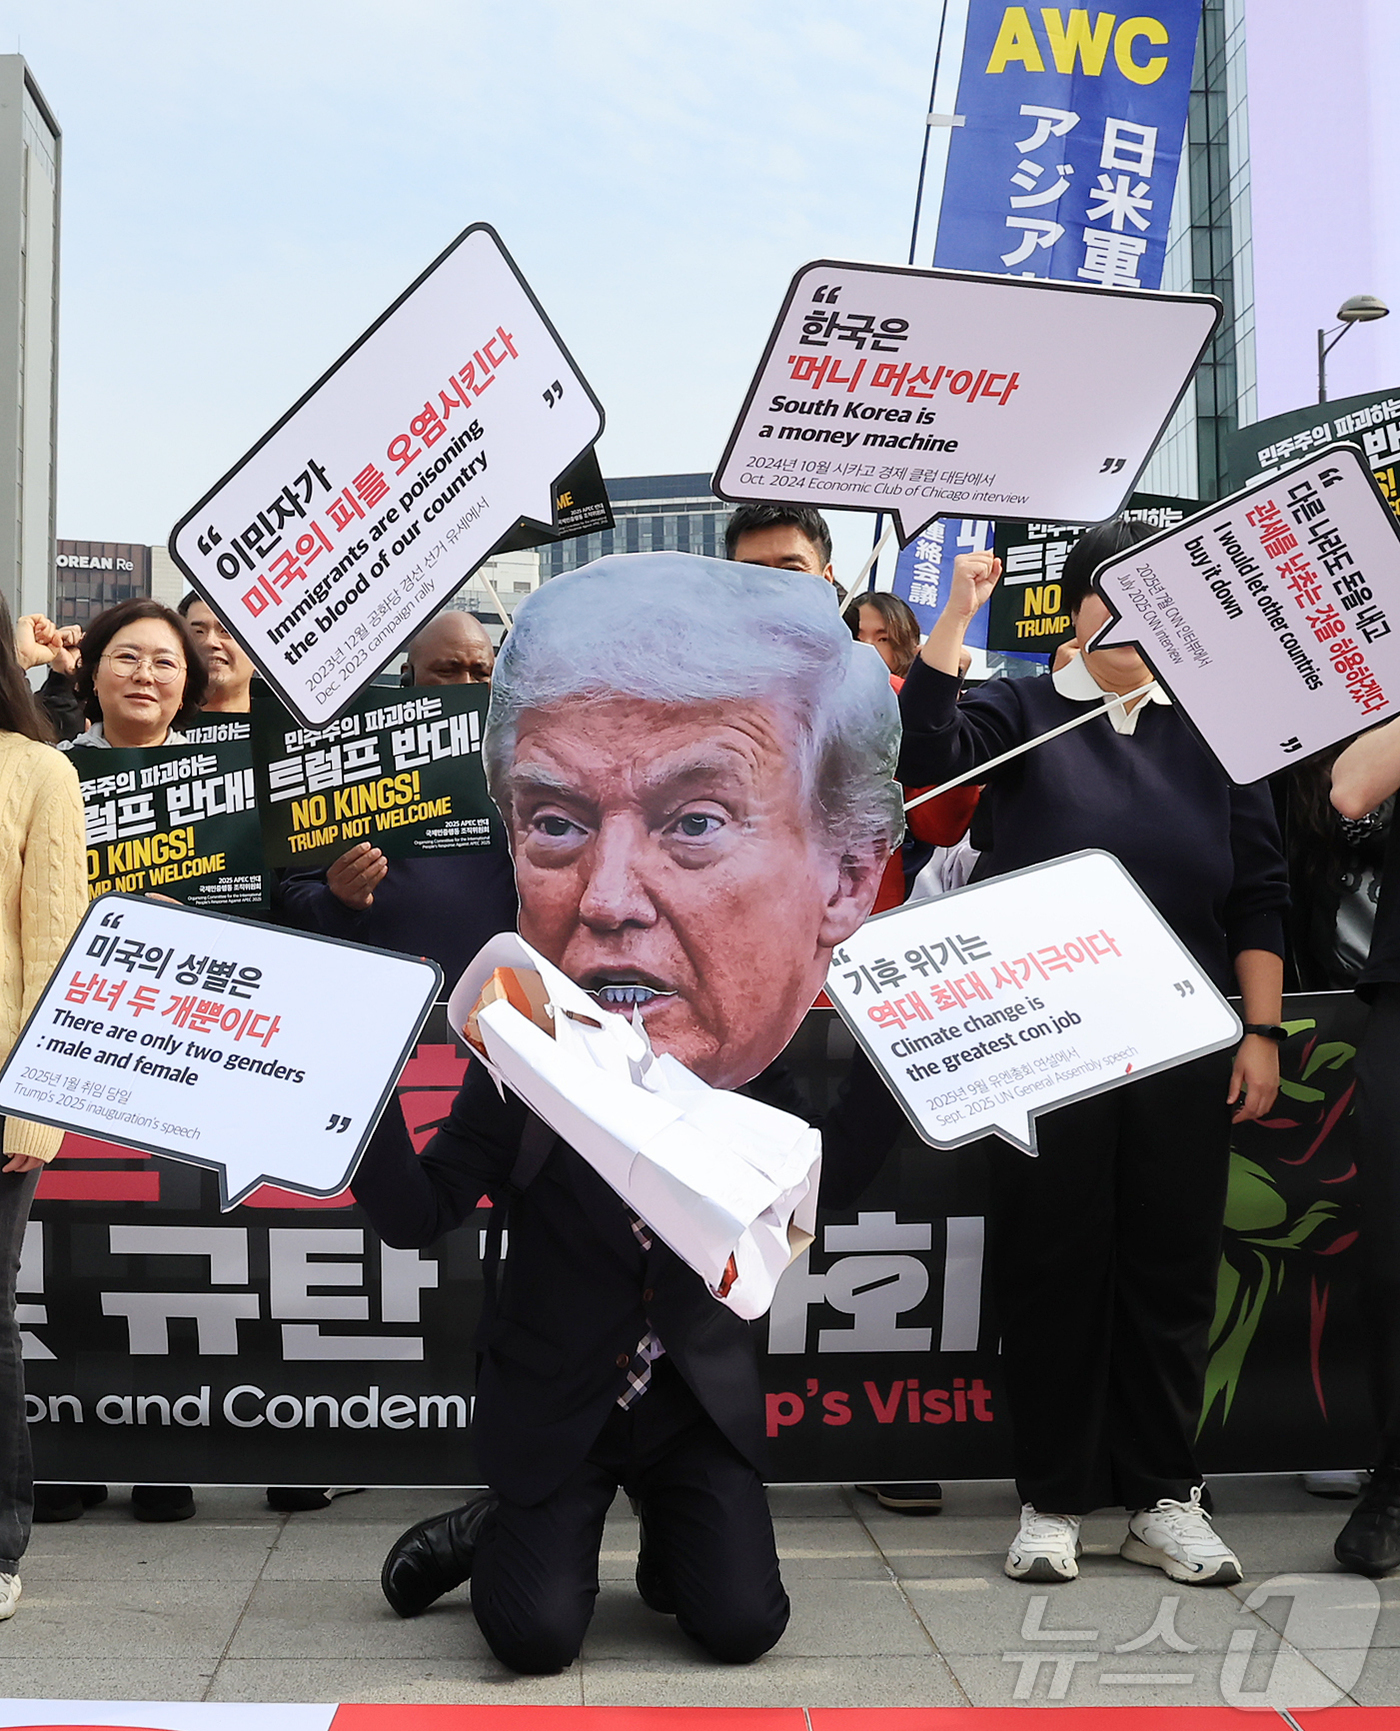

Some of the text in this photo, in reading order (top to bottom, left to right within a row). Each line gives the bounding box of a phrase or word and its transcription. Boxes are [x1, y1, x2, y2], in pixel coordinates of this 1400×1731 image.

[985, 7, 1169, 85] AWC
[1000, 104, 1081, 278] アジア
[799, 310, 910, 352] 한국은
[758, 424, 959, 453] a money machine
[768, 395, 936, 425] South Korea is
[241, 326, 519, 618] 미국의 피를 오염시킨다
[746, 455, 997, 488] 2024년 10월 시카고 경제 클럽 대담에서
[1257, 423, 1333, 468] 민주주의
[216, 458, 333, 580] 이민자가
[739, 472, 1030, 504] Oct. 2024 Economic Club of Chicago interview
[266, 418, 484, 645] Immigrants are poisoning
[284, 450, 488, 666] the blood of our country
[1286, 480, 1392, 645] 다른 나라도 돈을 내고
[116, 558, 134, 571] Re
[304, 495, 490, 692] 2023년 12월 공화당 경선 선거 유세에서
[1184, 535, 1244, 620] buy it down
[338, 649, 369, 682] 2023
[367, 601, 416, 652] campaign
[414, 580, 435, 604] rally
[1015, 615, 1071, 638] TRUMP
[1023, 584, 1062, 617] NO
[1116, 573, 1184, 665] July 2025 CNN interview
[1135, 562, 1213, 669] 2025년 7월 CNN 인터뷰에서
[1212, 521, 1324, 691] I would let other countries
[1245, 499, 1299, 559] 관세를
[1276, 552, 1323, 609] 낮추는
[1305, 603, 1346, 643] 것을
[1329, 638, 1390, 716] 허용하겠다
[284, 696, 442, 753] 민주주의 파괴하는
[140, 754, 218, 789] 파괴하는
[268, 711, 481, 803] 트럼프 반대!
[166, 768, 256, 827] 반대!
[287, 796, 452, 853] TRUMP NOT WELCOME
[291, 770, 421, 831] NO KINGS!
[445, 820, 460, 828] 2025
[460, 819, 477, 827] APEC
[107, 826, 196, 875] KINGS!
[115, 871, 146, 893] NOT
[149, 852, 226, 886] WELCOME
[86, 934, 263, 999] 미국의 성별은
[842, 934, 992, 996] 기후 위기는
[867, 929, 1123, 1030] 역대 최대 사기극이다
[65, 971, 281, 1048] 남녀 두 개뿐이다
[890, 996, 1045, 1058] Climate change is
[46, 1038, 199, 1086] male and female
[52, 1008, 306, 1084] There are only two genders
[906, 1010, 1082, 1082] the greatest con job
[19, 1066, 133, 1106] 2025년 1월 취임 당일
[925, 1046, 1081, 1112] 2025년 9월 유엔총회 연설에서
[935, 1045, 1139, 1127] Sept. 2025 UN General Assembly speech
[13, 1081, 201, 1141] Trump's 2025 inauguration's speech
[101, 1225, 439, 1360] 규탄
[96, 1386, 211, 1428] and
[223, 1384, 475, 1430] Condem
[863, 1378, 994, 1424] Visit
